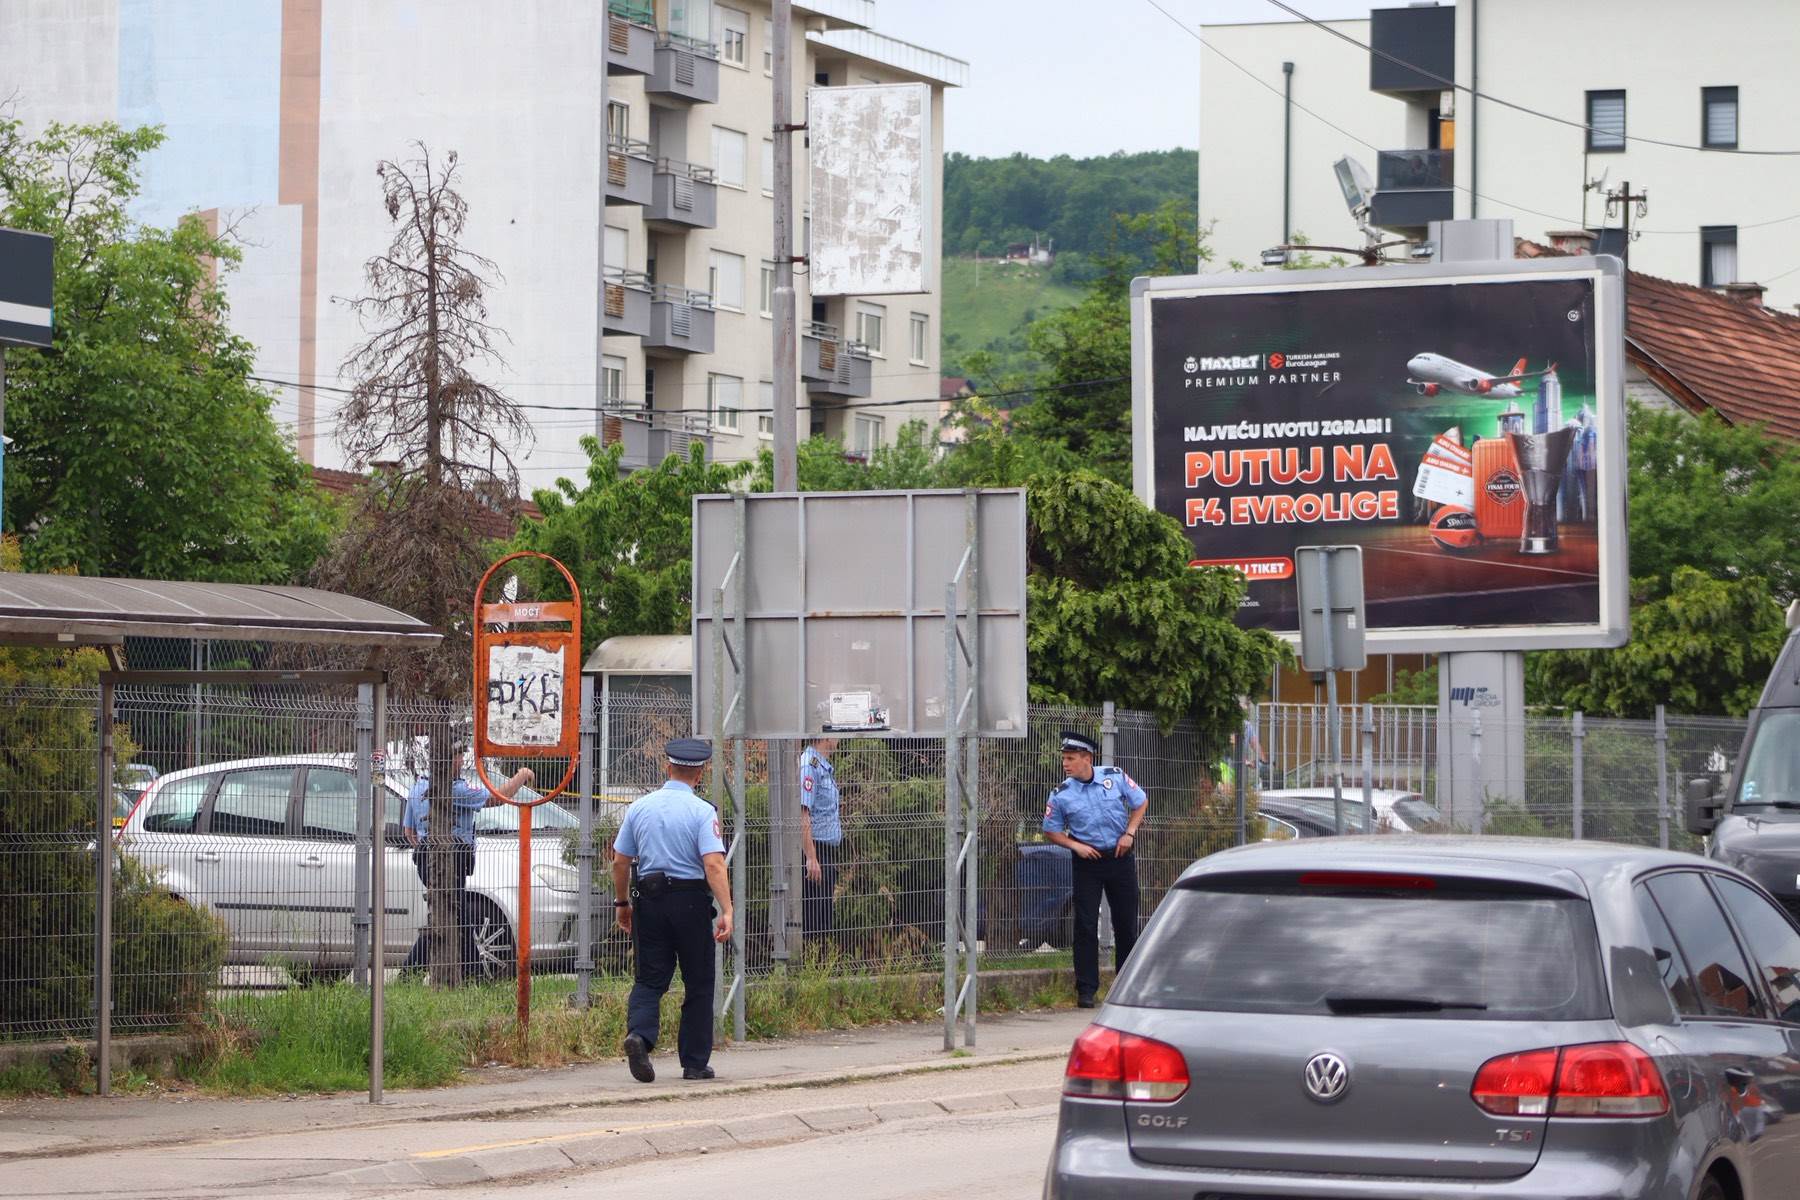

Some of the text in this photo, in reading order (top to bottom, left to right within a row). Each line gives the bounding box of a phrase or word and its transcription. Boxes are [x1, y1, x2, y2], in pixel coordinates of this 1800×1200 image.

[1185, 372, 1341, 388] PREMIUM PARTNER
[1184, 418, 1392, 442] NAJVEĆU KVOTU ZGRABI I
[1185, 443, 1398, 488] PUTUJ NA
[1186, 490, 1398, 526] F4 EVROLIGE
[1250, 563, 1285, 574] TIKET
[514, 608, 539, 617] МОСТ
[1137, 1114, 1189, 1128] GOLF
